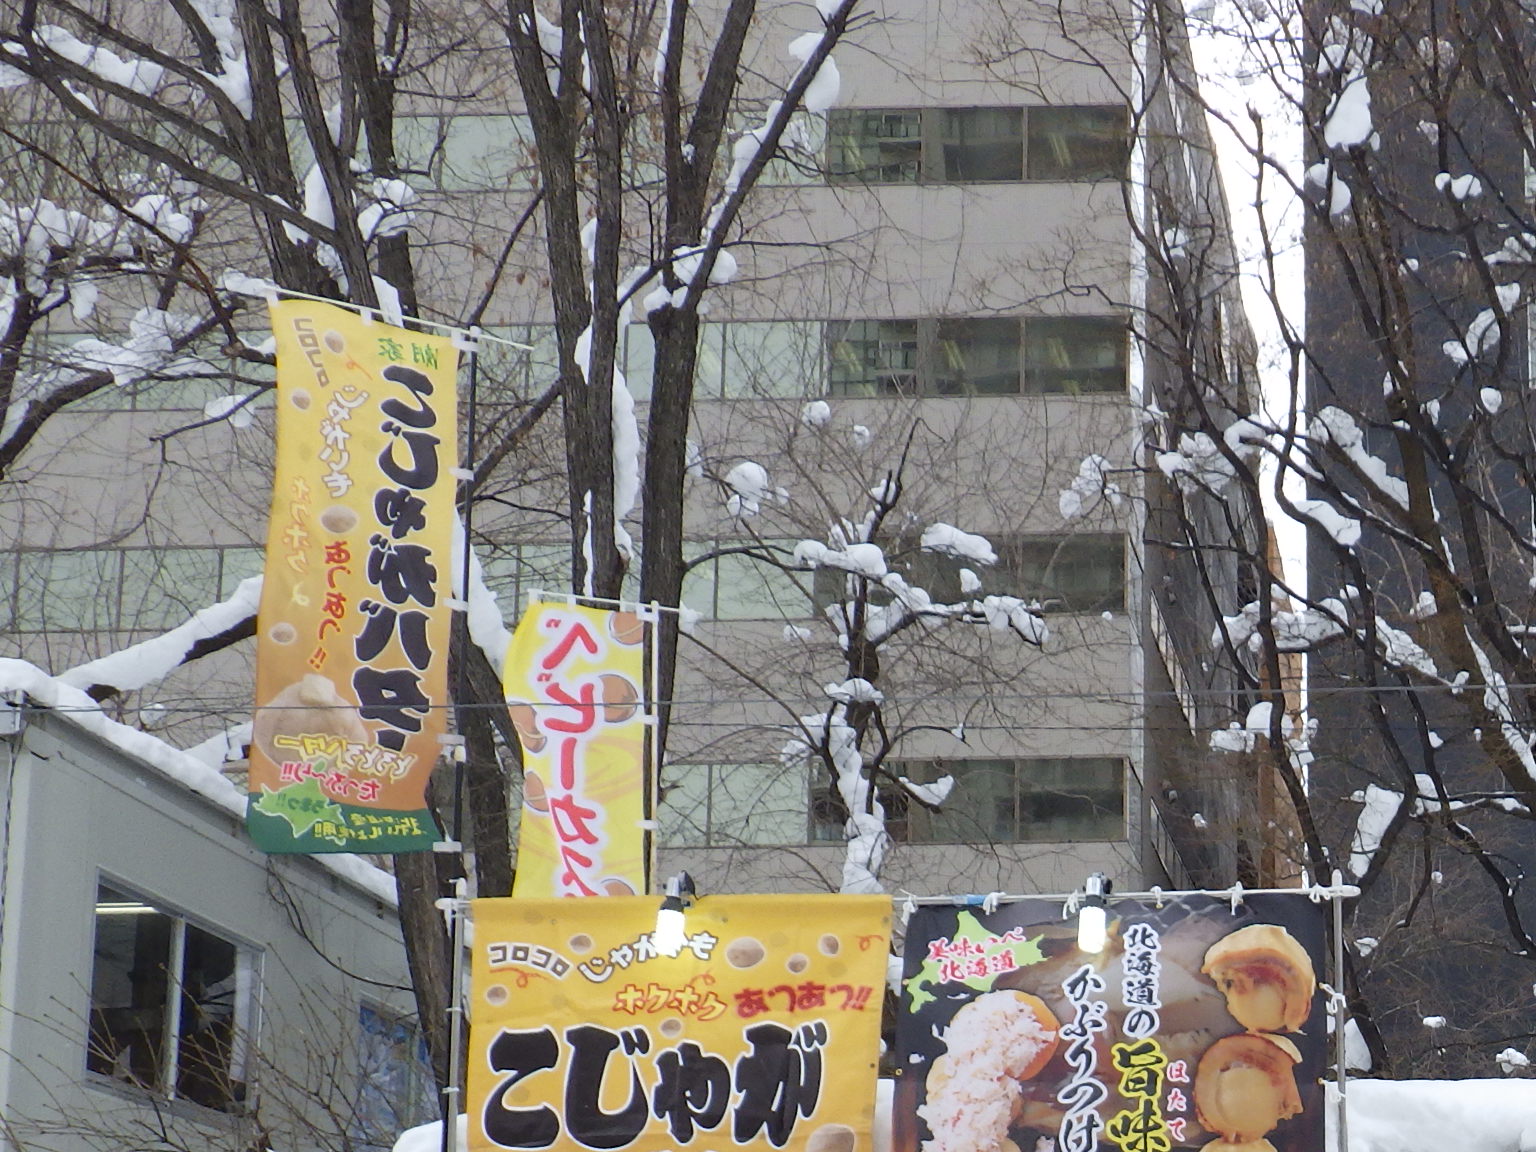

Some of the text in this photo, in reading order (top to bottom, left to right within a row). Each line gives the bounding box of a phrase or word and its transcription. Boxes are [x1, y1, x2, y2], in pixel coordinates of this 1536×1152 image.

[487, 942, 573, 980] コロコロ
[938, 951, 1017, 982] 北海道
[612, 983, 729, 1021] ホクホク
[483, 1019, 828, 1150] こじゃが
[1167, 1061, 1189, 1143] ほたて
